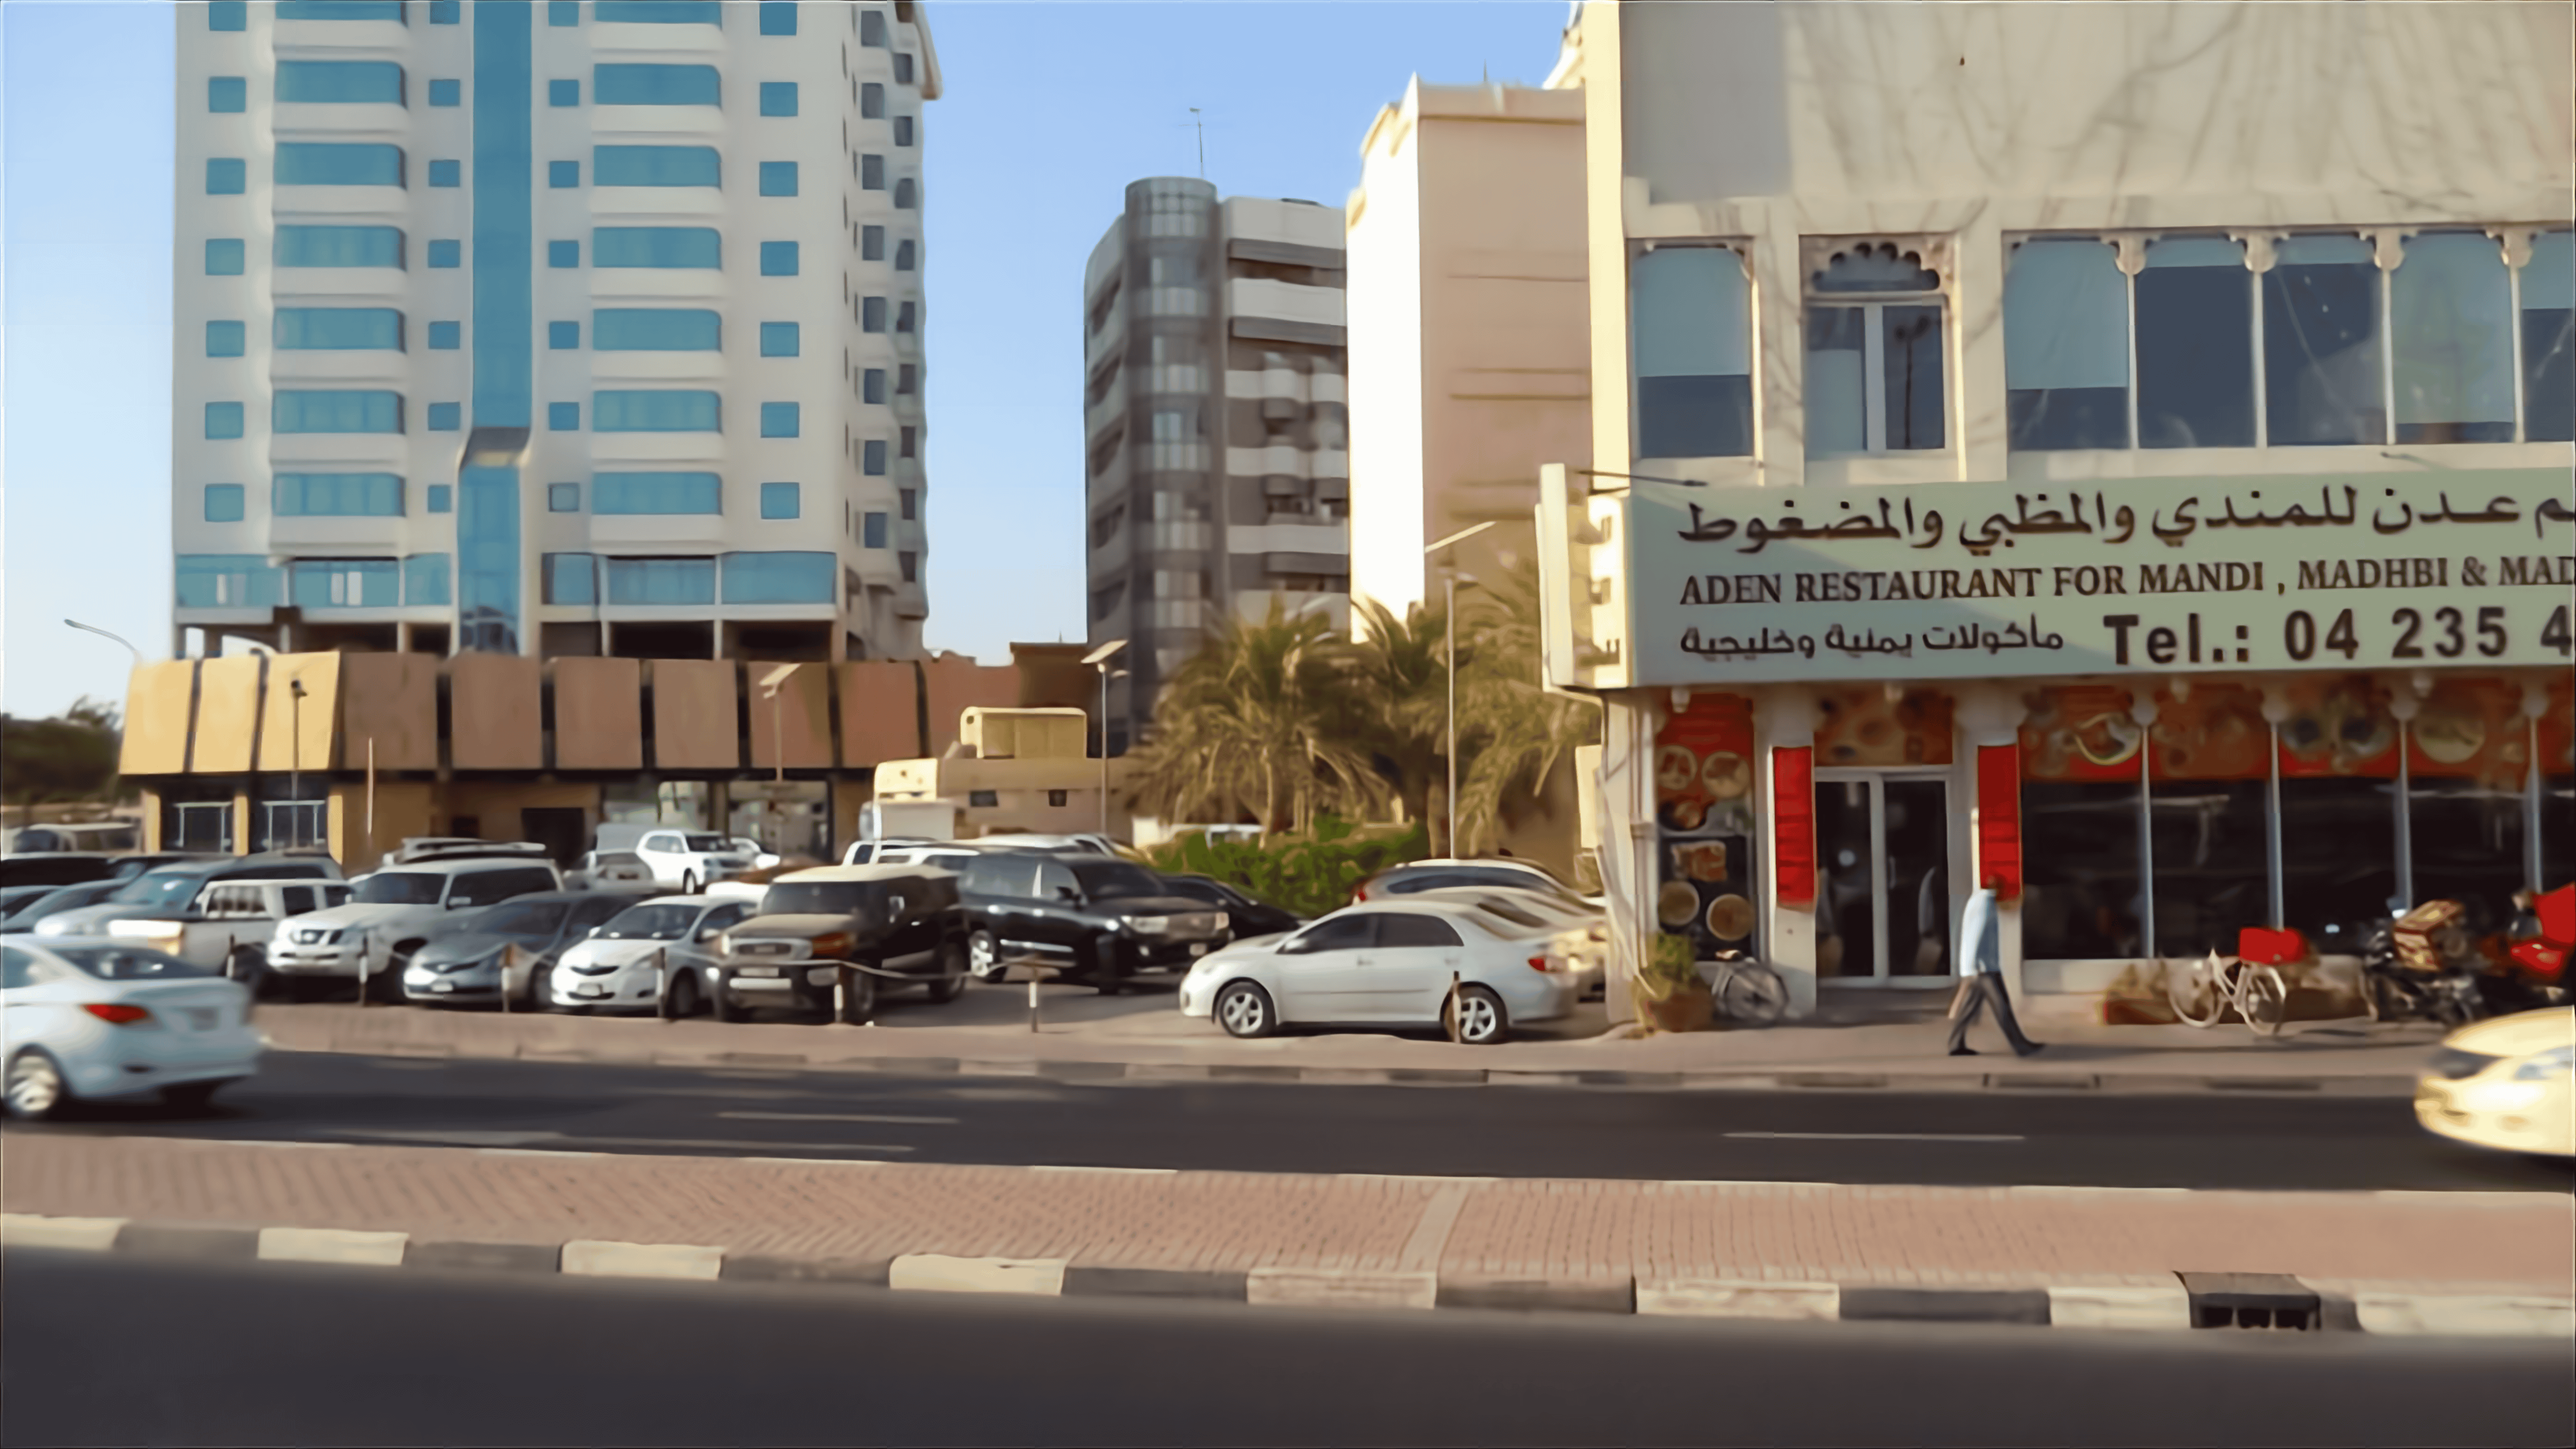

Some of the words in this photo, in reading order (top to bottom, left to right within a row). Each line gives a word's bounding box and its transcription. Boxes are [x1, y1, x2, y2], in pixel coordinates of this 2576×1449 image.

[1677, 497, 1943, 553] والمضغوط
[2152, 484, 2356, 547] للمندي
[2373, 488, 2520, 535] عدن
[2535, 498, 2574, 539] م
[1680, 574, 1781, 604] ADEN
[1795, 568, 2042, 602] RESTAURANT
[2053, 566, 2127, 596] FOR
[2139, 562, 2263, 594] MANDI
[2298, 558, 2448, 590] MADHBI
[2461, 556, 2487, 586] &
[2103, 614, 2249, 665] Tel.:
[2284, 609, 2358, 661] 04
[2391, 606, 2507, 658] 235
[2540, 605, 2573, 657] 4
